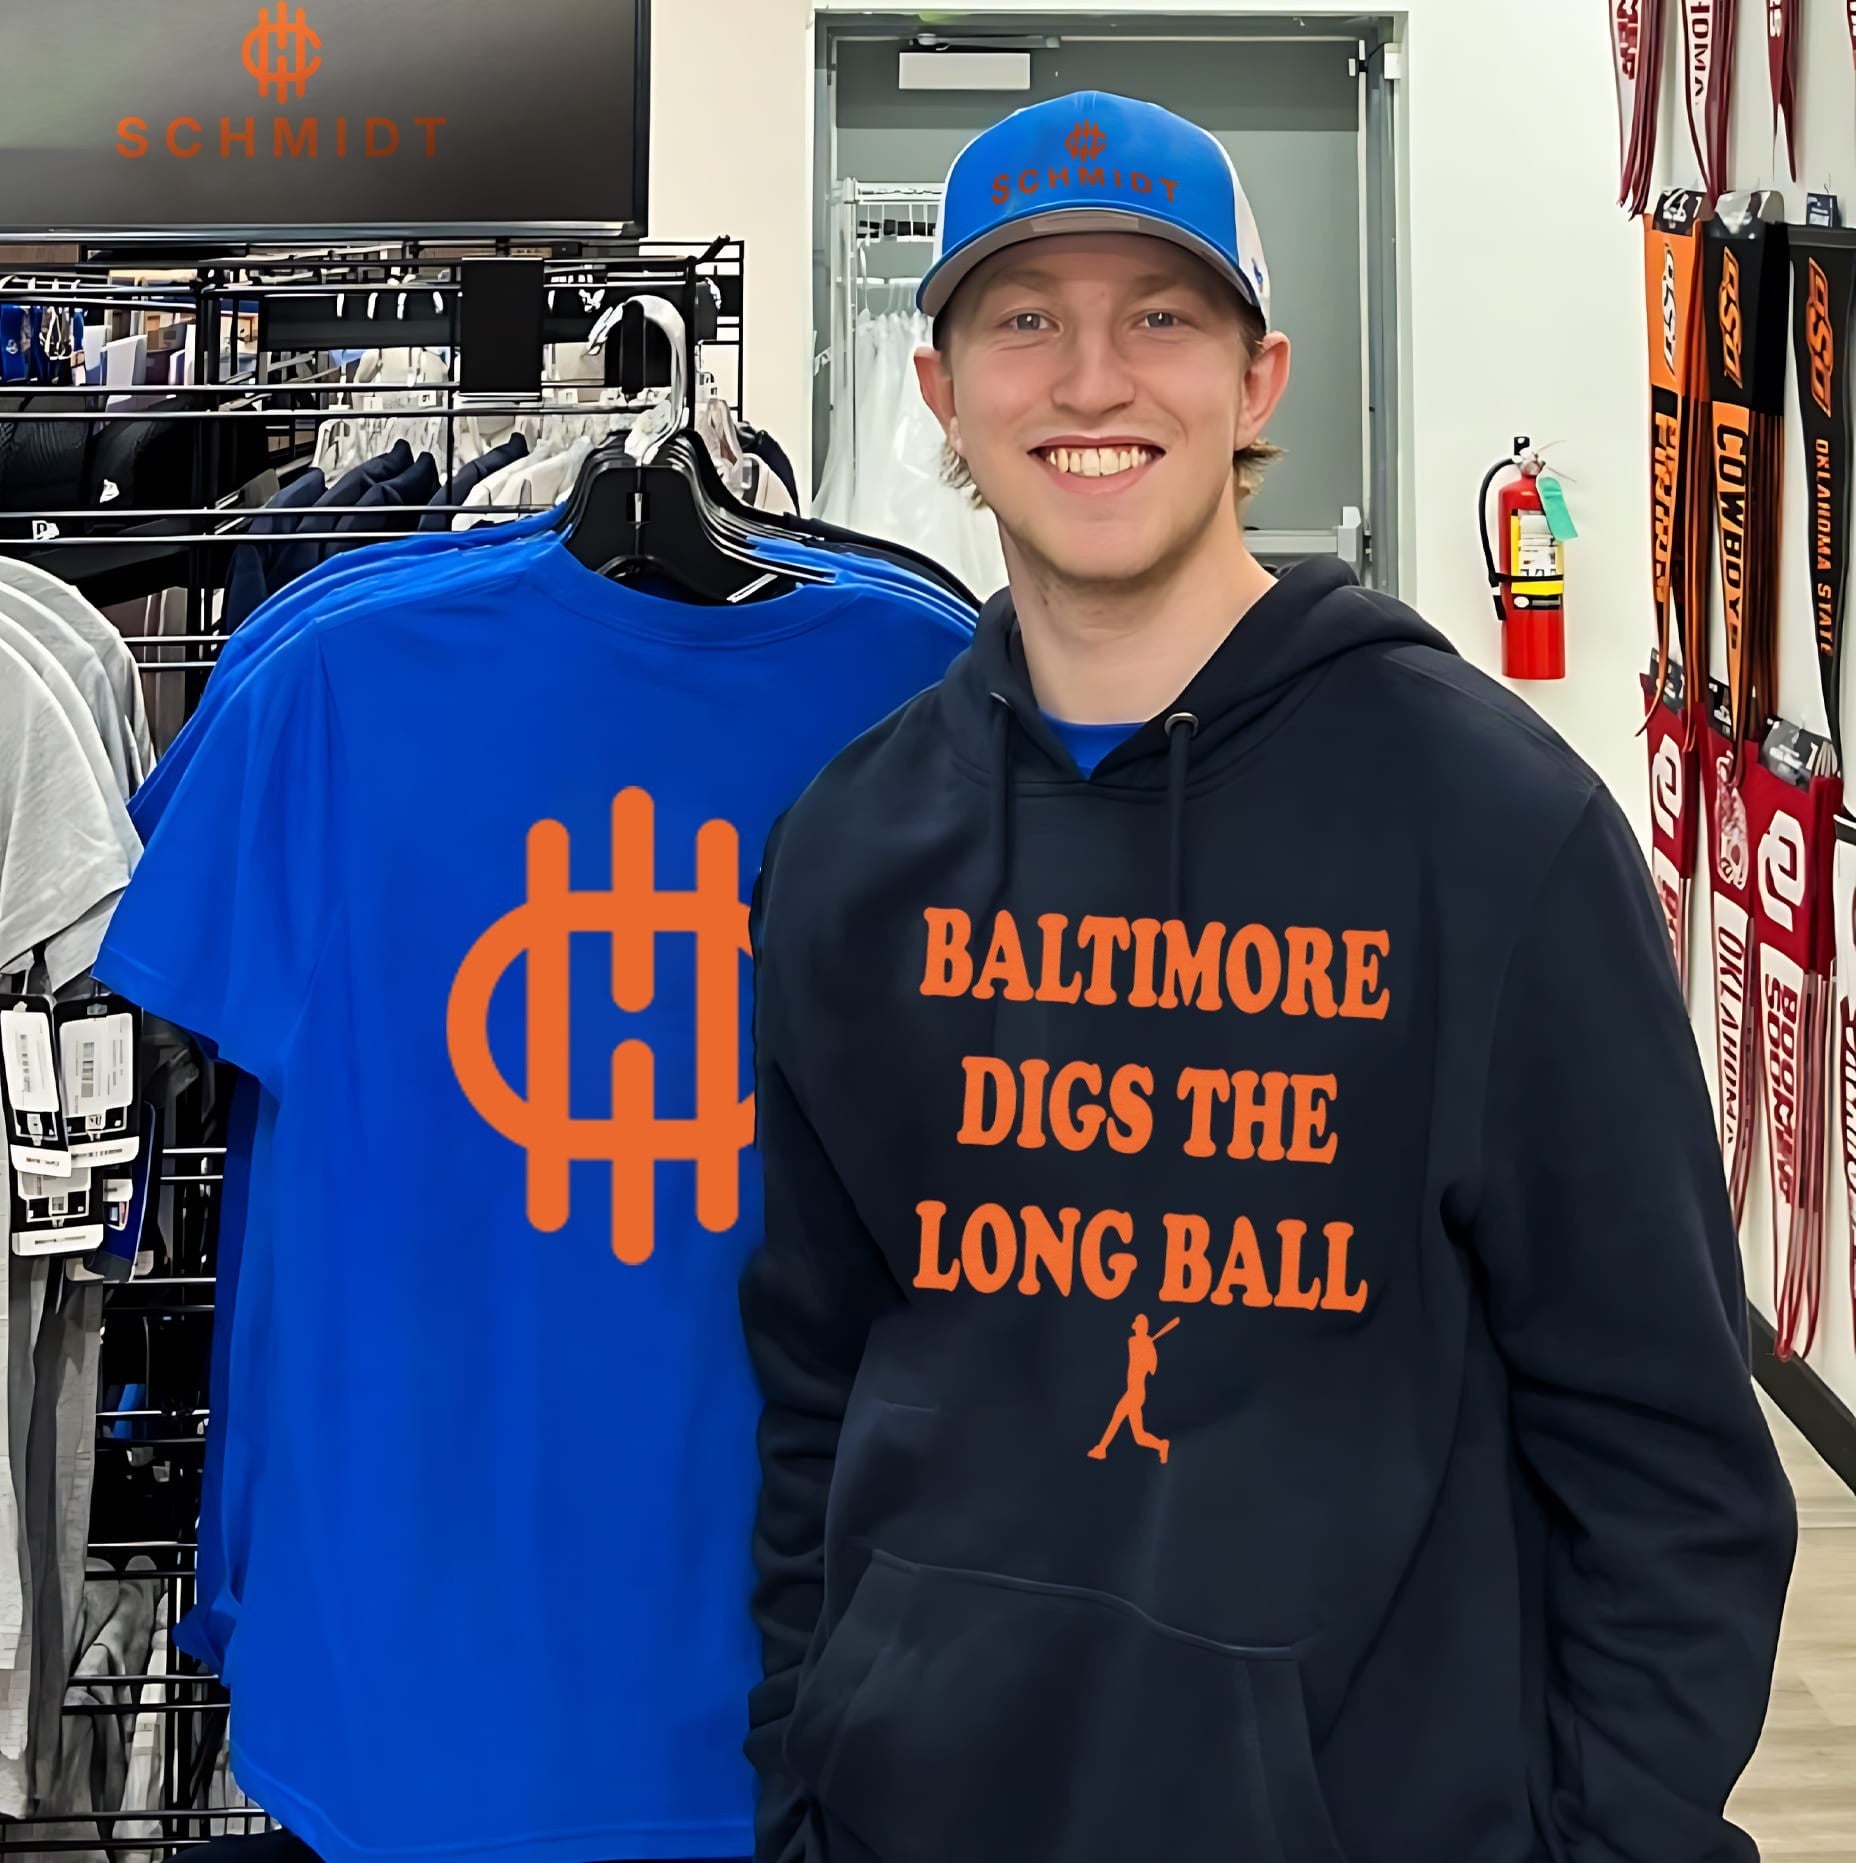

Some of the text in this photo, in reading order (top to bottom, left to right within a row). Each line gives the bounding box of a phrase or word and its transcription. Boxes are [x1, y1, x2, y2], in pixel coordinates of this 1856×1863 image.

[115, 115, 448, 160] SCHMIDT
[991, 166, 1179, 205] SCHMIDT
[919, 907, 1390, 1020] BALTIMORE
[956, 1056, 1338, 1164] DIGS THE
[913, 1200, 1368, 1313] LONG BALL
